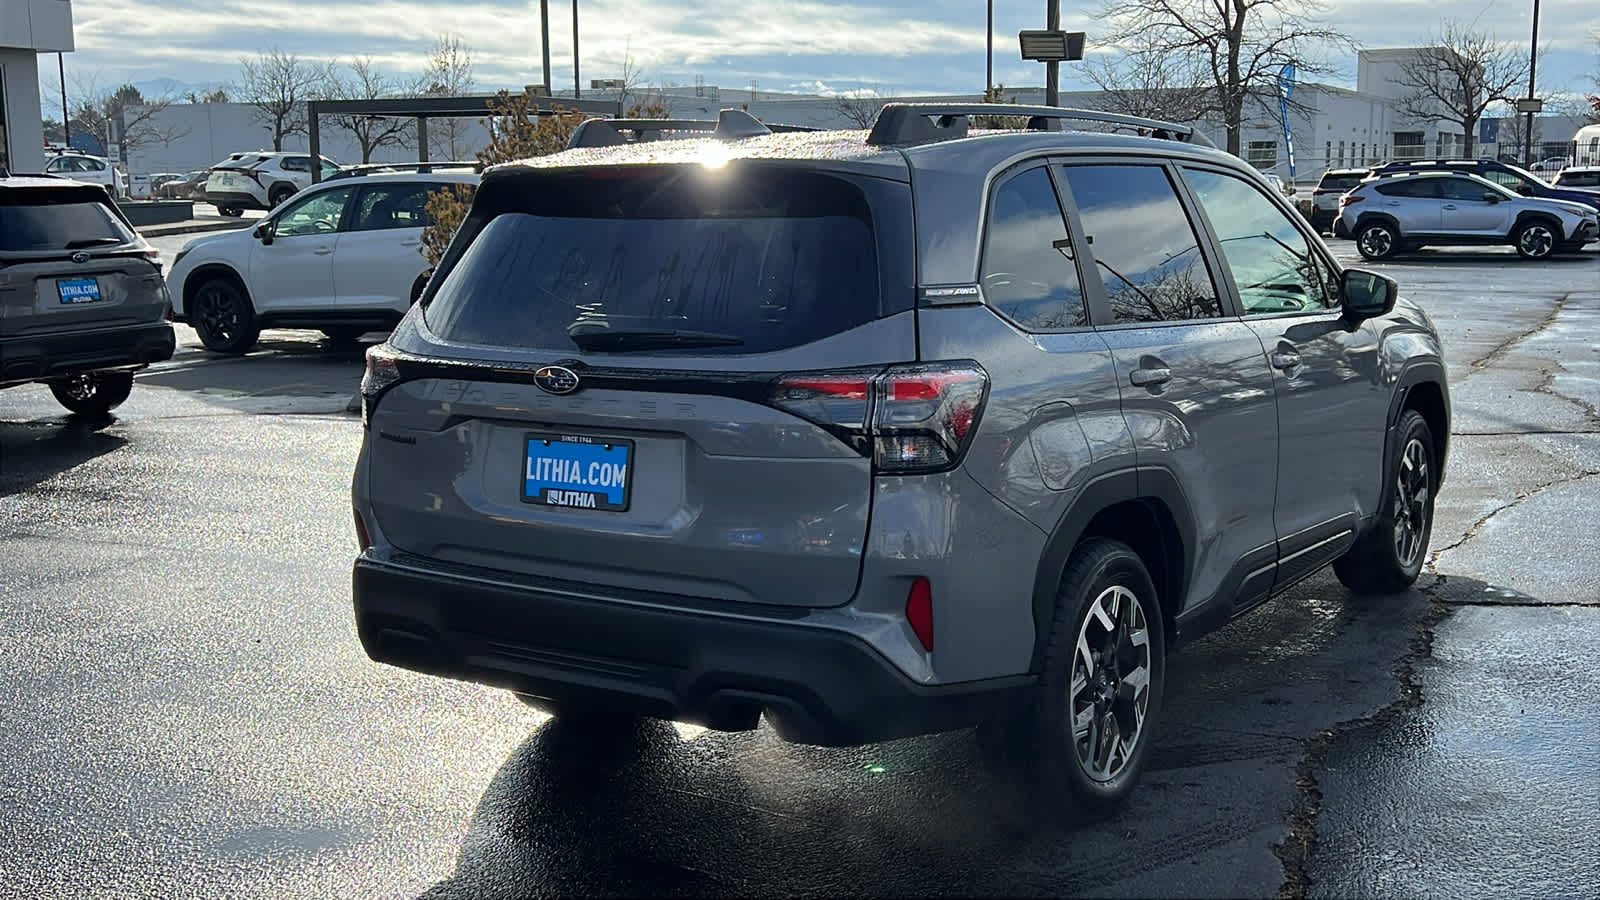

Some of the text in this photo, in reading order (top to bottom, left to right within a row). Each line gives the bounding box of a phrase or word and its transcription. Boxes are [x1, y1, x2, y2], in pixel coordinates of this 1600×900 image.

[60, 284, 99, 296] LITHIA.COM
[953, 287, 978, 295] AWD
[561, 435, 579, 444] SINCE
[526, 456, 627, 488] LITHIA.COM
[558, 489, 597, 508] LITHIA
